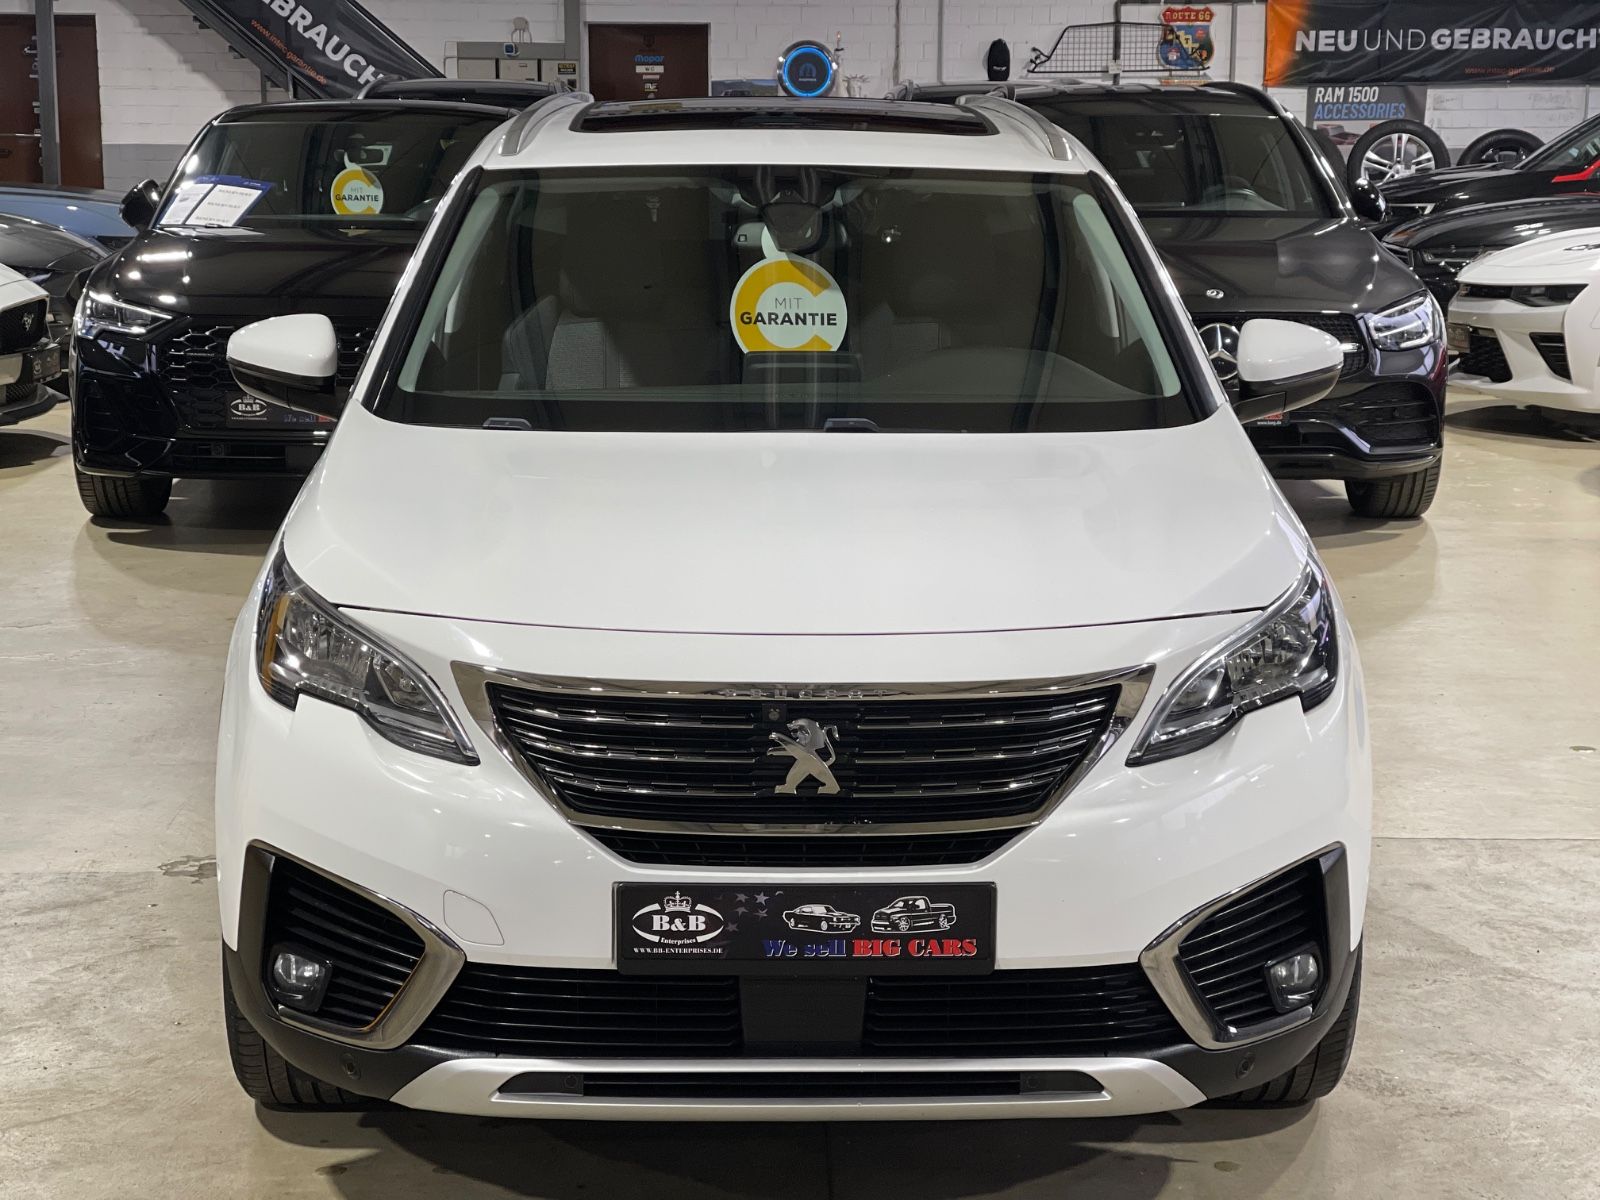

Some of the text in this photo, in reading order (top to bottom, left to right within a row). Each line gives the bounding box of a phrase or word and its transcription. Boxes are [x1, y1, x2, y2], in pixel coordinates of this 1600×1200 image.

[1165, 11, 1211, 20] ROUTE 66
[262, 0, 385, 85] BRAUCH
[1295, 27, 1600, 51] NEU UND GEBRAUCH
[1315, 86, 1379, 103] RAM 1500
[1314, 103, 1406, 119] ACCESSORIES
[335, 194, 379, 202] GARANTIE
[775, 298, 802, 310] MIT
[740, 312, 837, 326] GARANTIE
[238, 403, 260, 411] B&B
[651, 915, 706, 931] B&B
[660, 937, 696, 945] Enterprises
[762, 939, 977, 957] We sell BIG CARS
